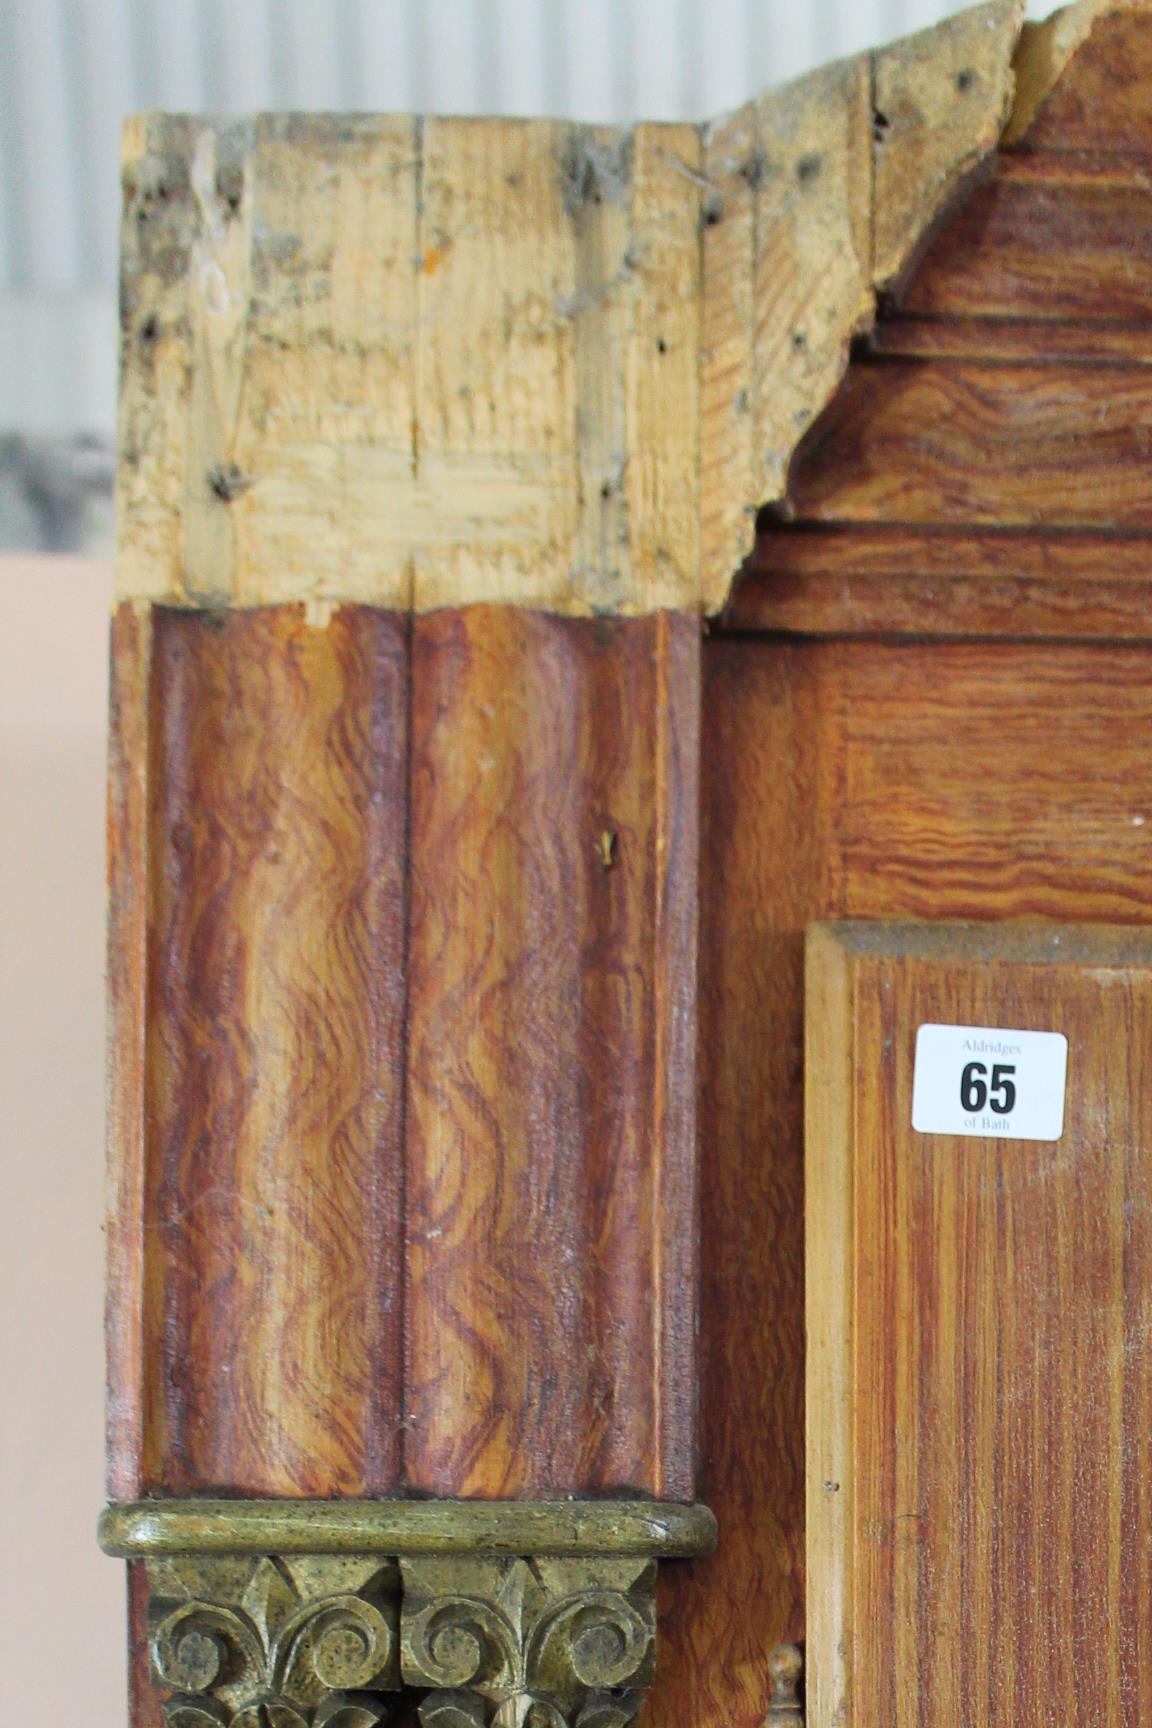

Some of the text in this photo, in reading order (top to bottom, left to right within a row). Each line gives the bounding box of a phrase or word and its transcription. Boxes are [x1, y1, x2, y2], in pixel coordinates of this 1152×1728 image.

[960, 1061, 1016, 1115] 65
[963, 1117, 1011, 1131] of Bath
